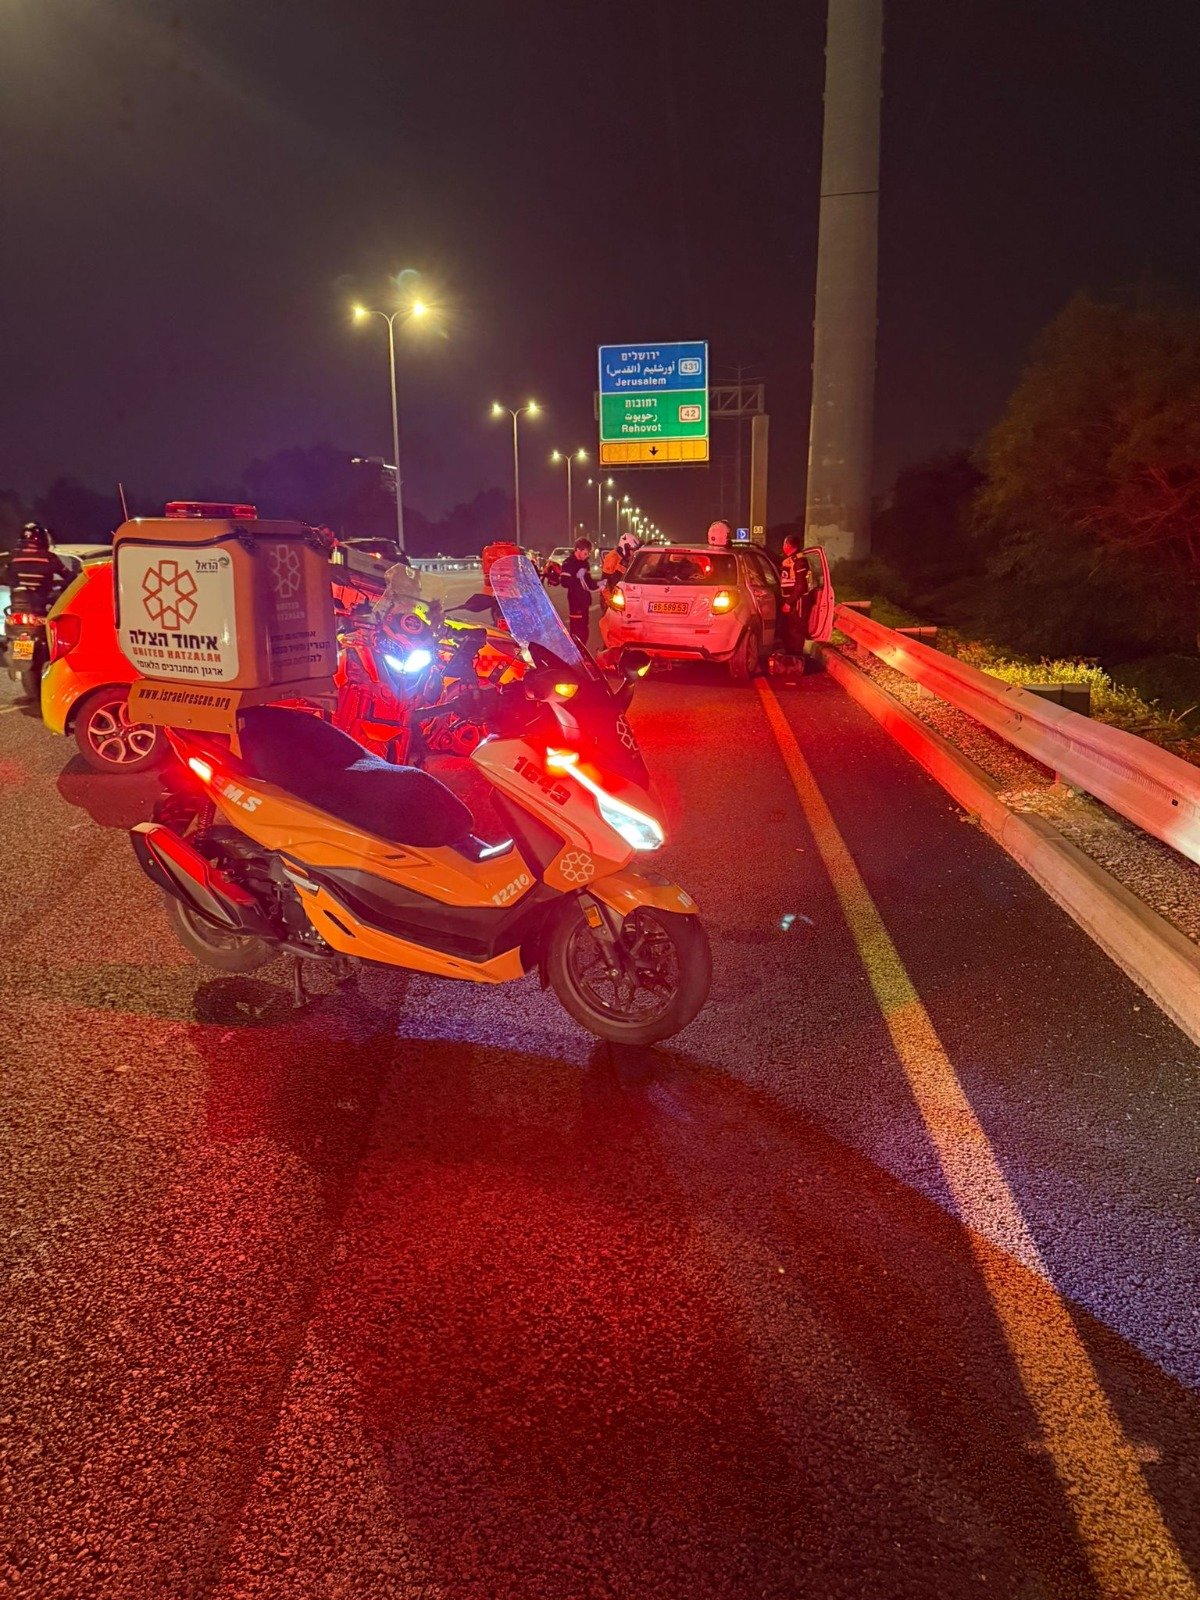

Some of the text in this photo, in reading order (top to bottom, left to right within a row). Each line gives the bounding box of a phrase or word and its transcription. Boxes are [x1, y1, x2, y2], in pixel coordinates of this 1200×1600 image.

[621, 351, 660, 361] ירושלים
[683, 363, 698, 372] 431
[615, 377, 667, 386] Jerusalem
[625, 399, 657, 408] רחובות
[684, 409, 696, 418] 42
[621, 424, 661, 433] Rehovot
[195, 560, 219, 570] הראל
[129, 629, 219, 651] איחוד הצלה
[132, 647, 222, 663] UNITED HATZALAH
[136, 660, 223, 676] ארגון המתנדבים הלאומי
[138, 688, 232, 710] www.israelrescue.org
[492, 873, 530, 906] 12210
